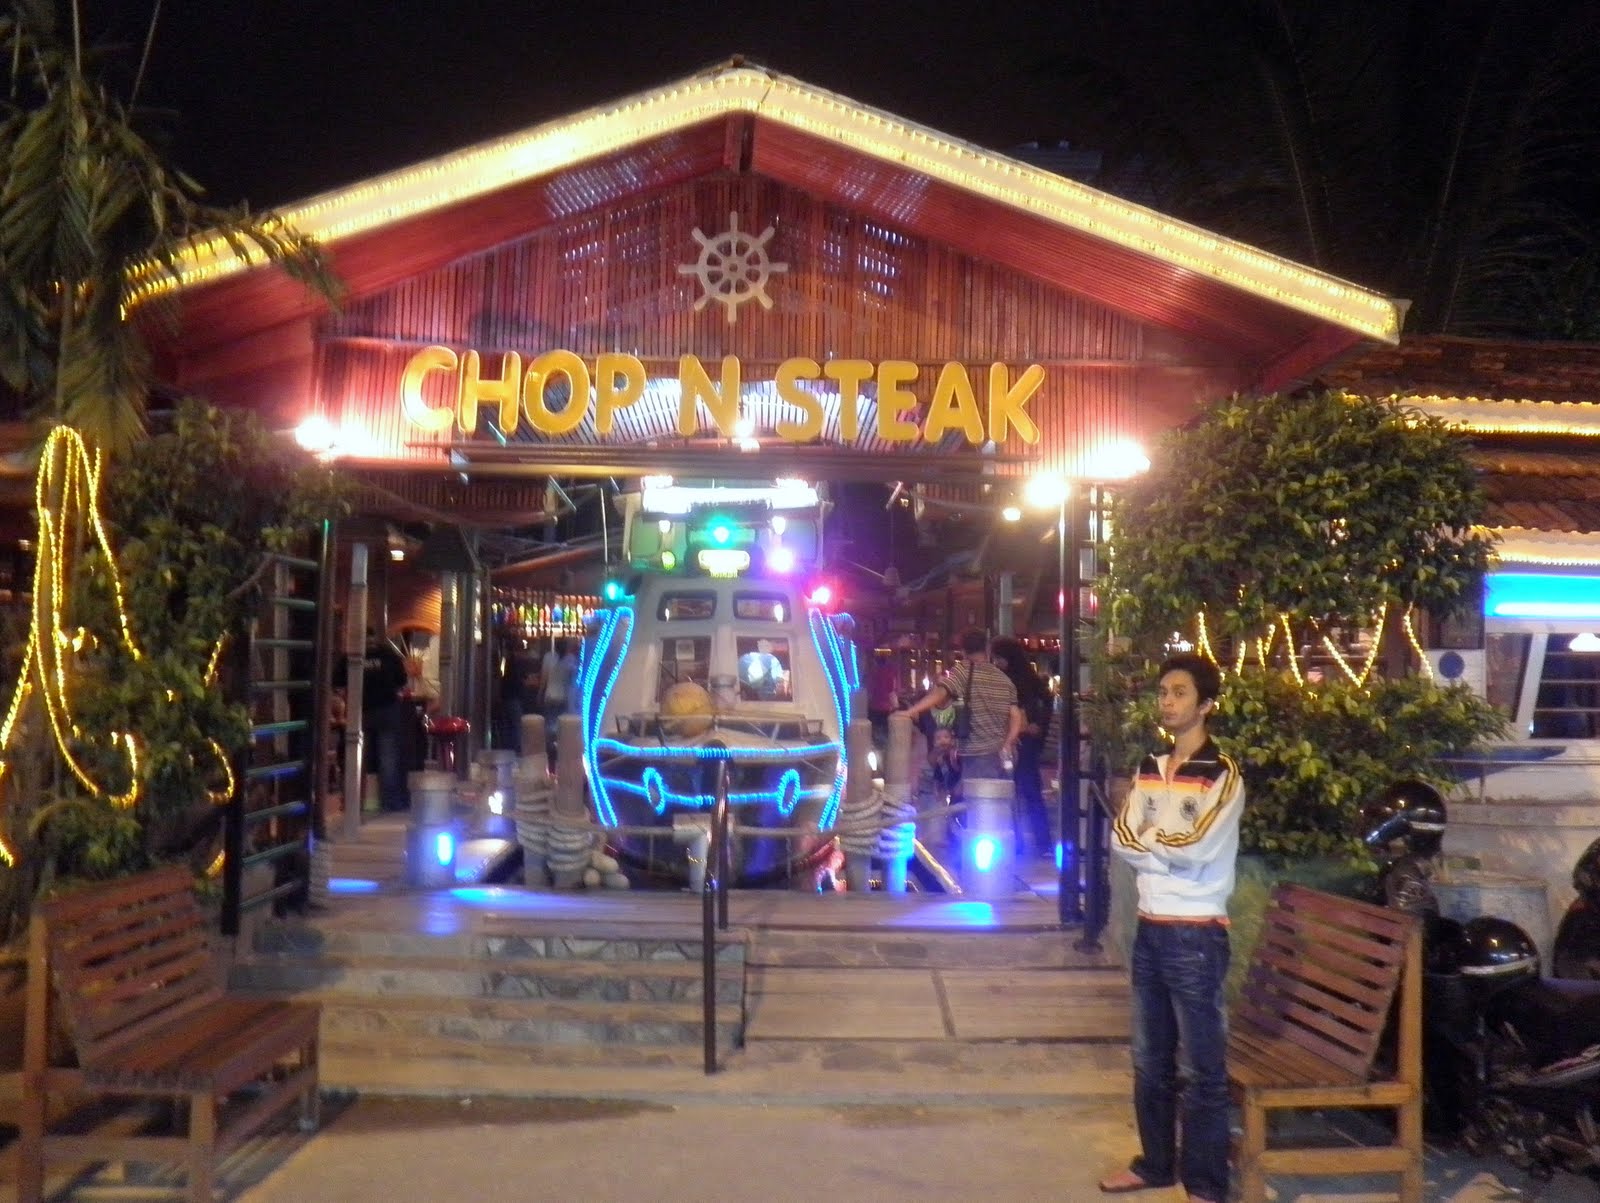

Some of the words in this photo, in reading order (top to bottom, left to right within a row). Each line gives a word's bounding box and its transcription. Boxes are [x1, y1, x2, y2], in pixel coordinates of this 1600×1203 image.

[401, 345, 647, 435] CHOP
[678, 354, 742, 437] N
[774, 358, 1046, 445] STEAK
